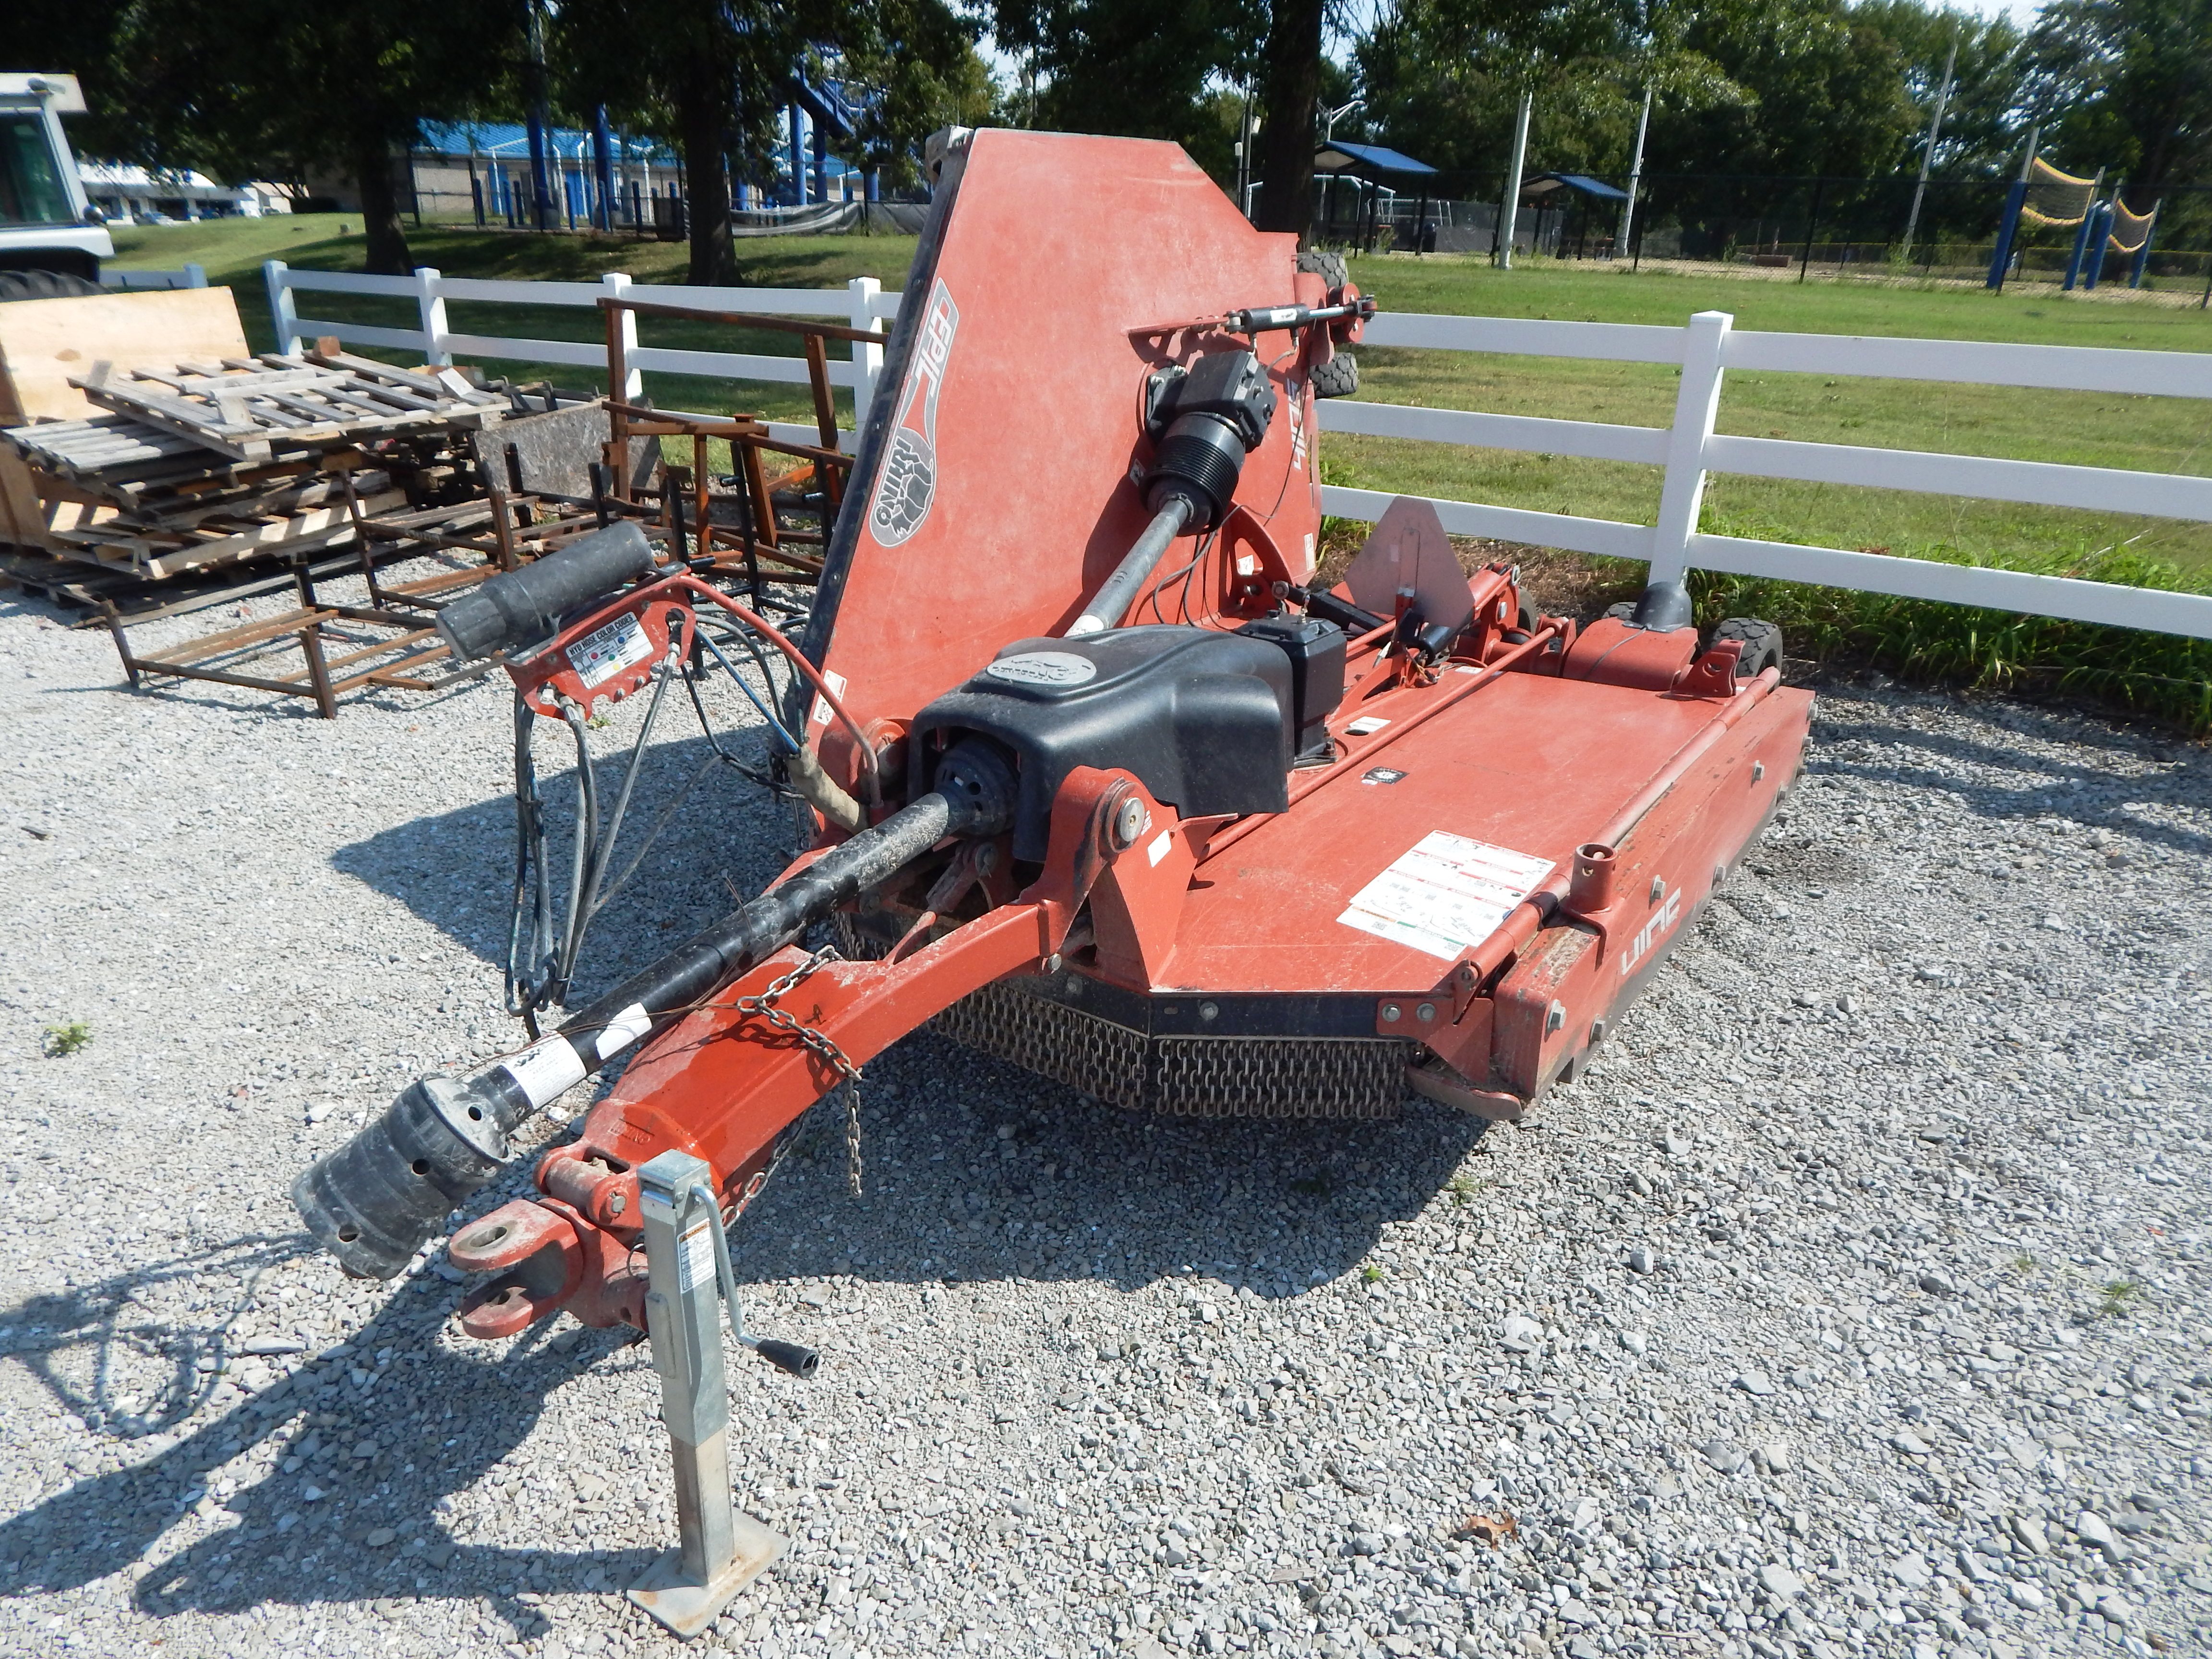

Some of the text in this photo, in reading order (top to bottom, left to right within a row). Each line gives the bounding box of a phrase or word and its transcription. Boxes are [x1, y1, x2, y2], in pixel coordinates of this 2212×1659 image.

[915, 305, 952, 397] EPIC
[875, 435, 913, 528] RHINO
[569, 645, 582, 656] HYD
[581, 635, 597, 648] HOSE
[596, 625, 615, 639] COLOR
[614, 614, 634, 629] CODES
